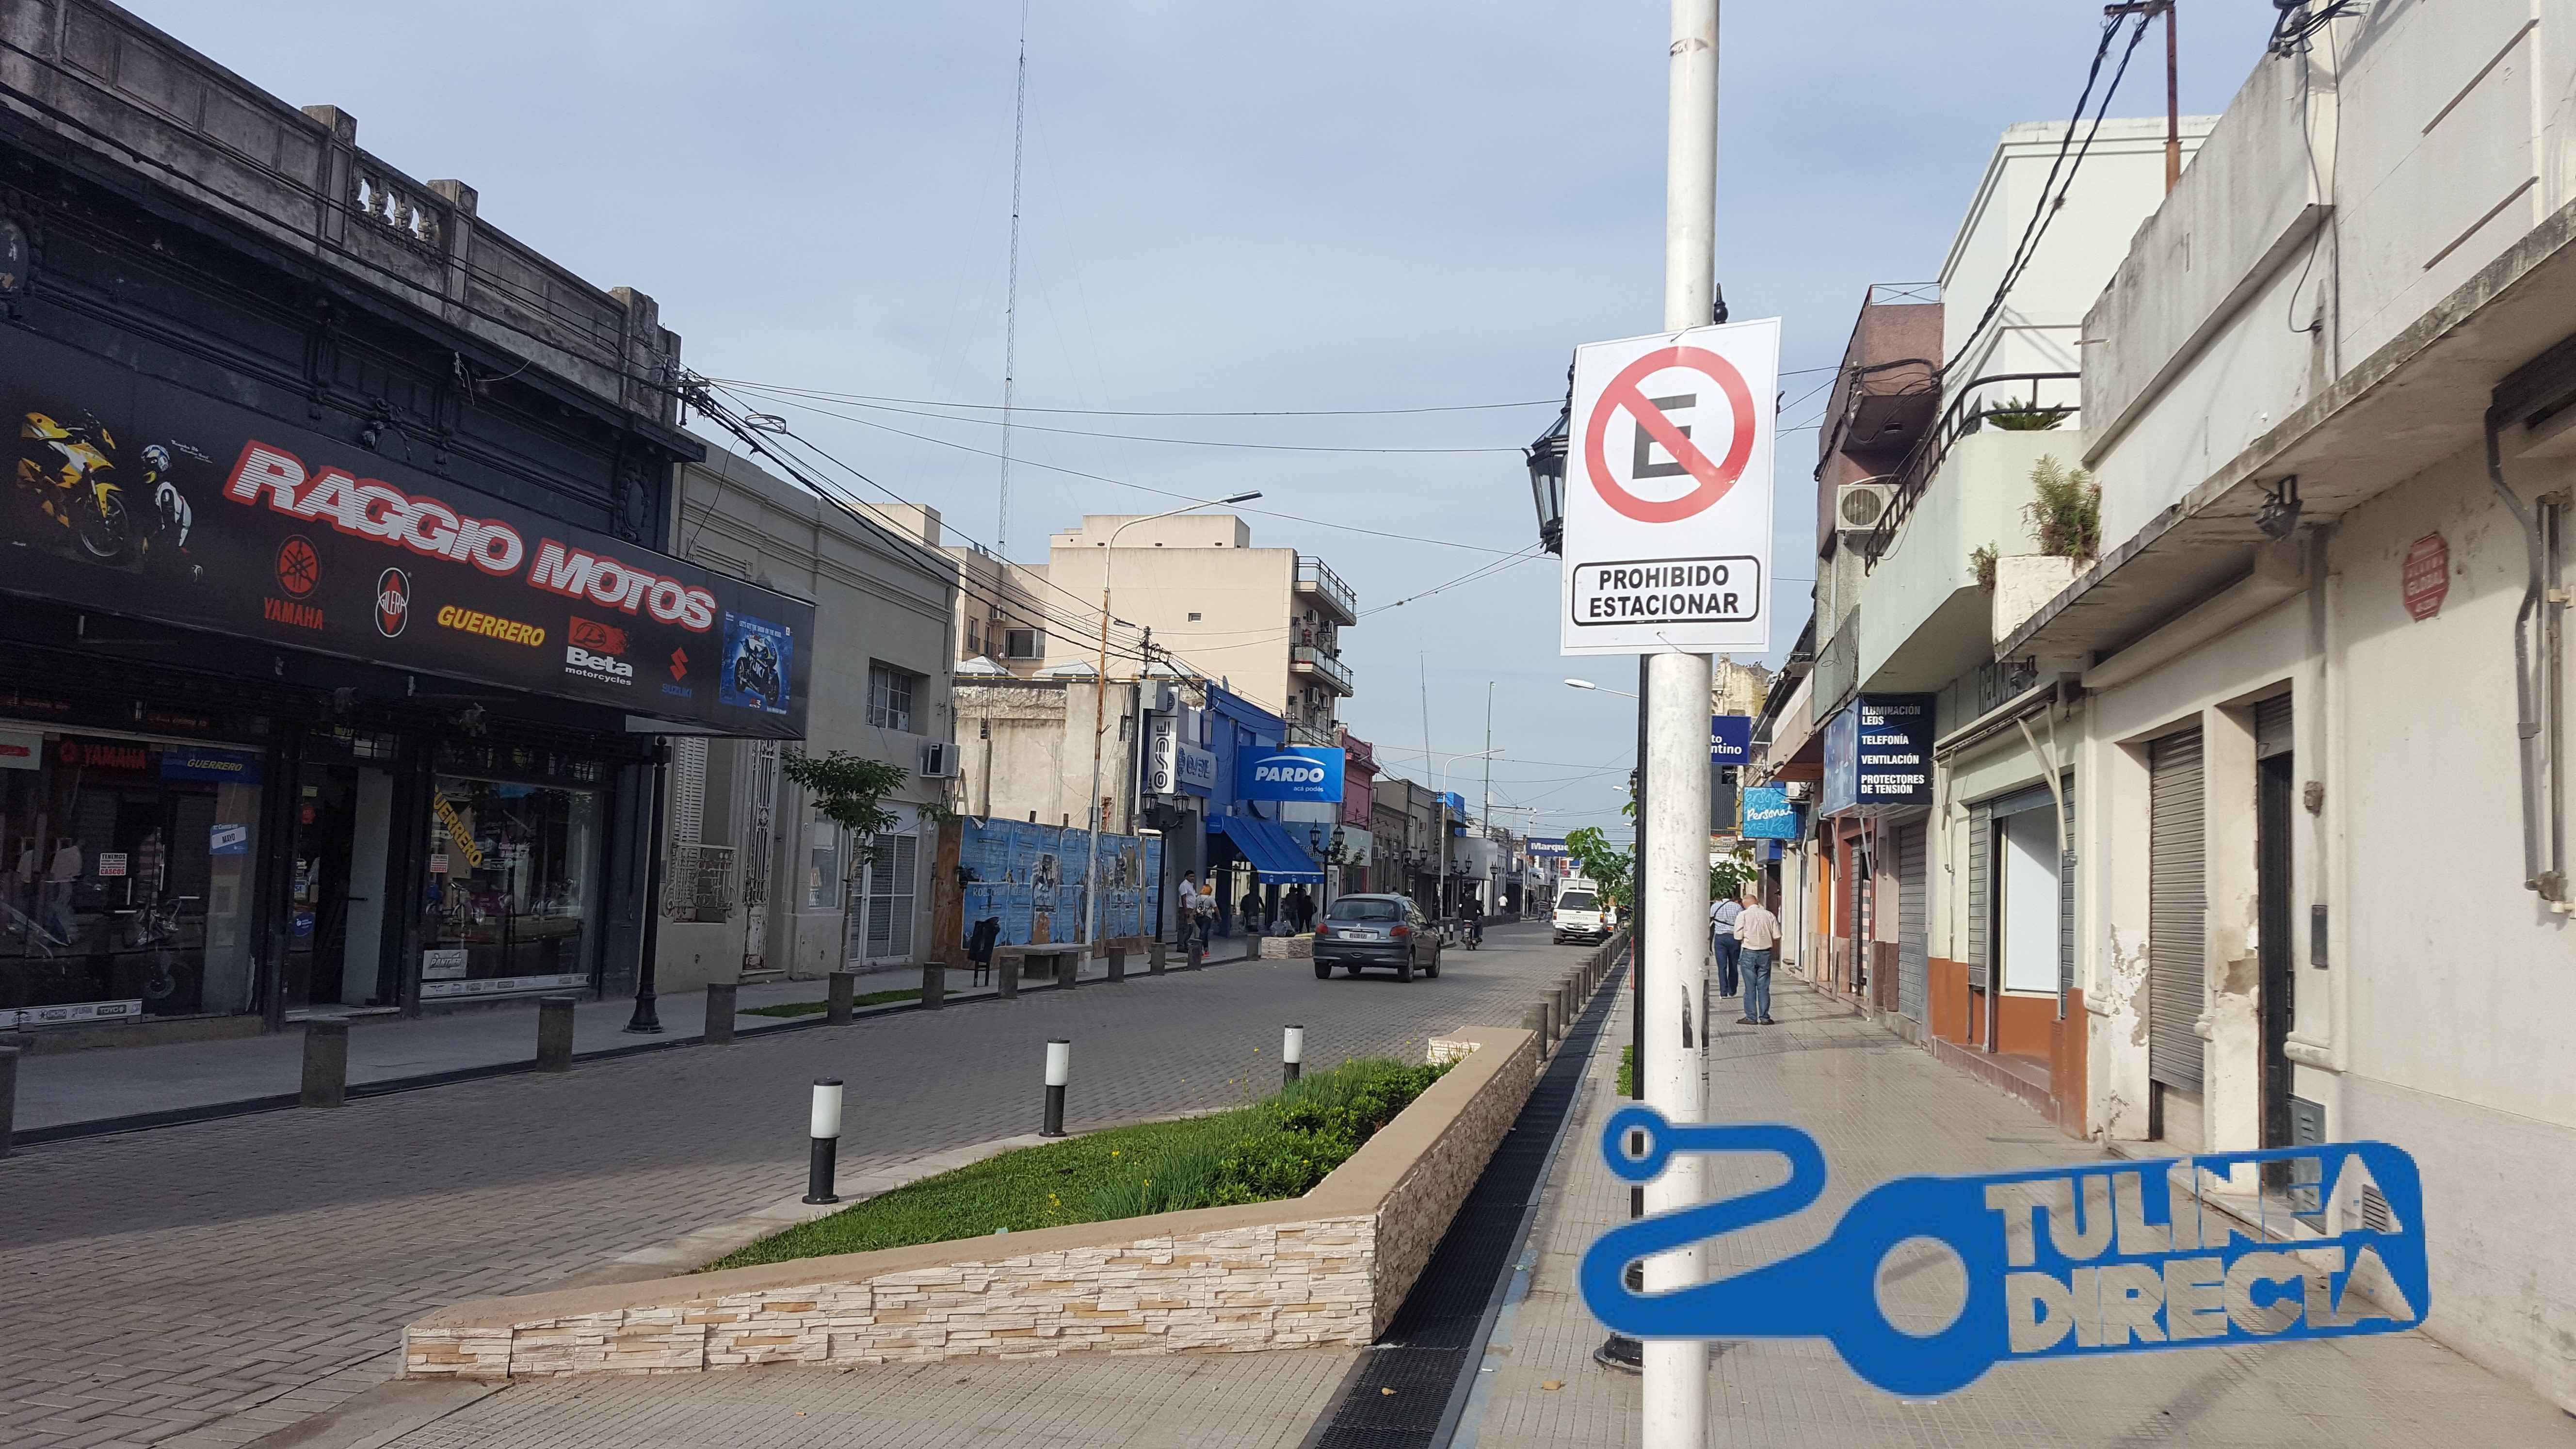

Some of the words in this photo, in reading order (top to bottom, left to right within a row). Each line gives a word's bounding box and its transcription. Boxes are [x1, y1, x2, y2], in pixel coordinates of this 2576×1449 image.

[232, 447, 524, 572] RAGGIO
[531, 543, 716, 629] MOTOS
[1599, 564, 1729, 591] PROHIBIDO
[379, 590, 406, 615] GILERA
[1589, 592, 1739, 618] ESTACIONAR
[264, 597, 323, 630] YAMAHA
[437, 605, 546, 646] GUERRERO
[566, 645, 633, 677] Beta
[565, 667, 632, 686] motorcycles
[662, 683, 692, 698] SUZUKI
[1862, 704, 1921, 715] ILUMINACIÓN
[1862, 716, 1884, 725] LEDS
[1861, 733, 1909, 745] TELEFONÍA
[85, 744, 146, 769] YAMAHA
[187, 758, 244, 772] GUERRERO
[1861, 753, 1919, 765] VENTILACIÓN
[1255, 766, 1325, 783] PARDO
[1861, 774, 1925, 784] PROTECTORES
[1861, 784, 1873, 794] DE
[1875, 783, 1913, 794] TENSIÓN
[1747, 804, 1794, 821] Personal
[222, 833, 236, 843] MAYO
[1531, 842, 1569, 853] Marque
